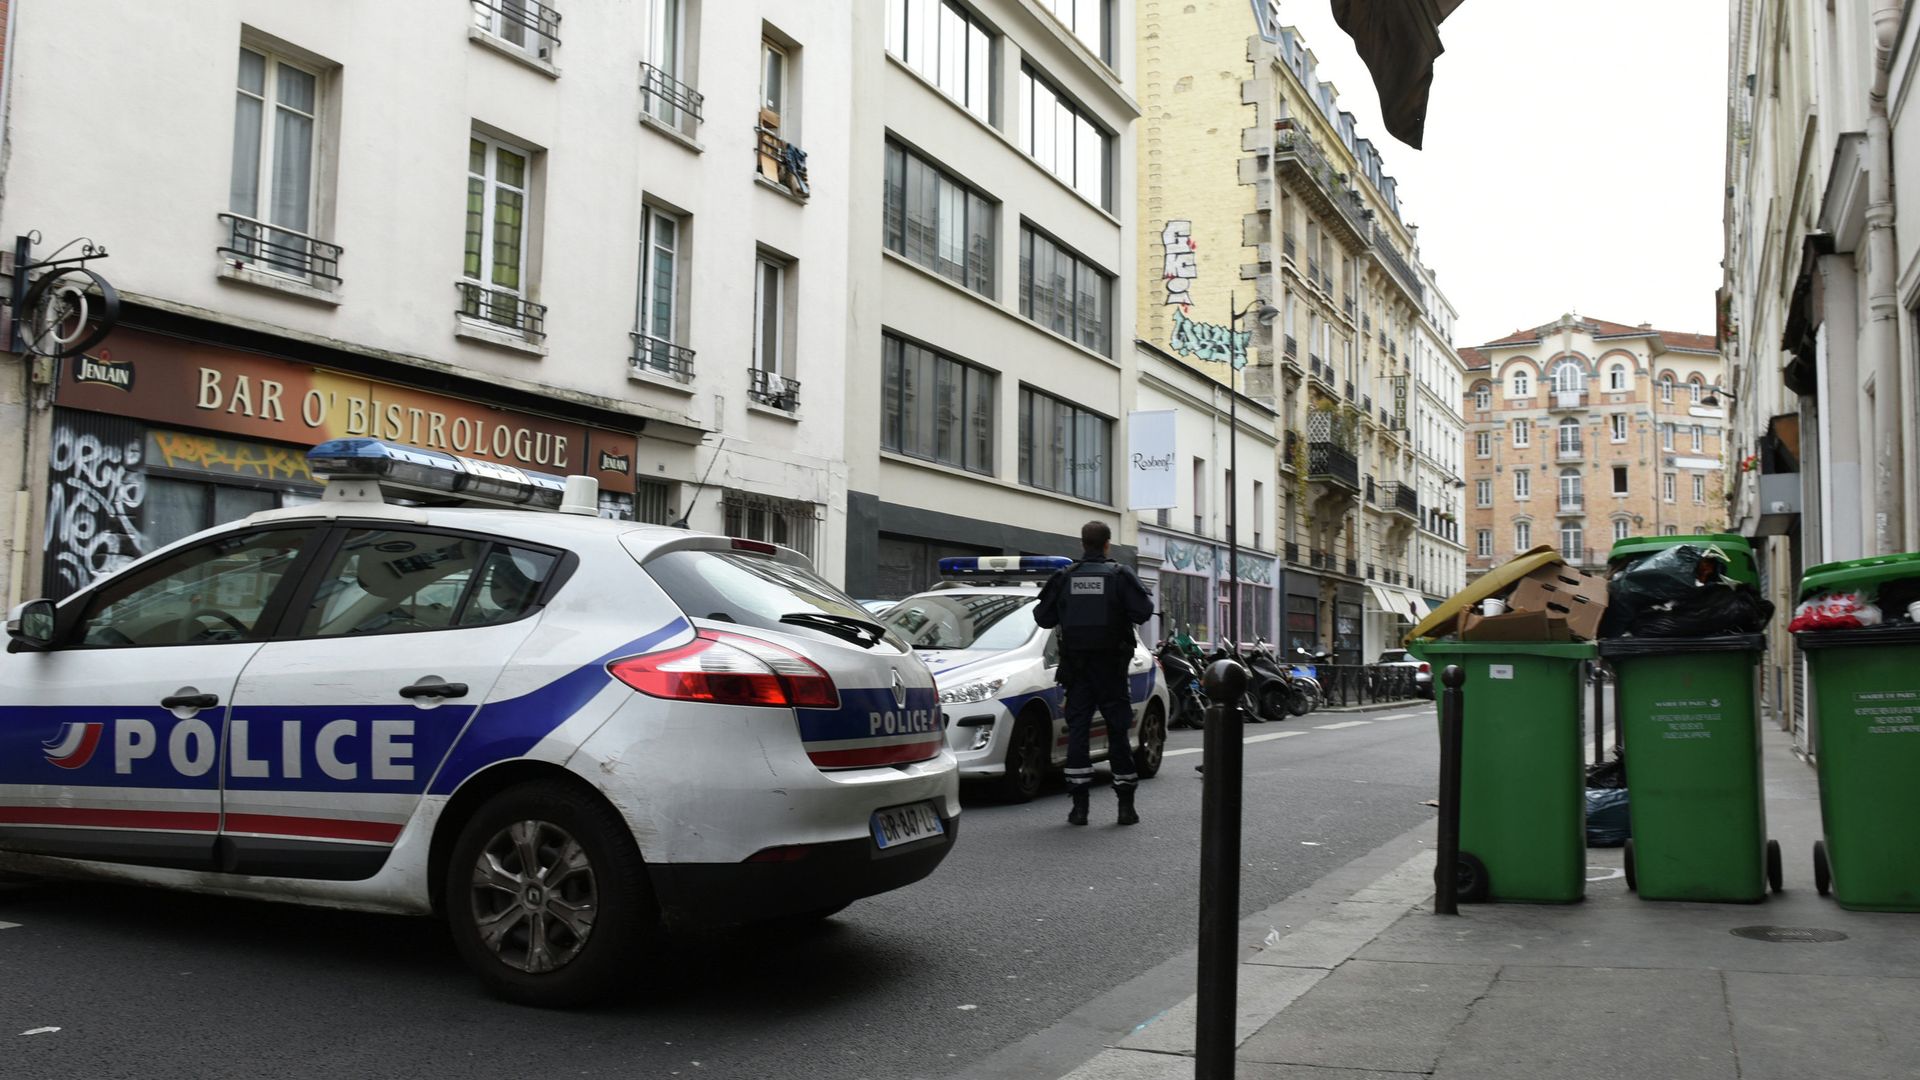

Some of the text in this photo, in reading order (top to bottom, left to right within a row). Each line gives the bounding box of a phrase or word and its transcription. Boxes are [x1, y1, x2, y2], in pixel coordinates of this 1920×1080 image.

[78, 359, 129, 385] JENLAIN
[197, 367, 285, 422] BAR
[347, 396, 569, 469] BISTROLOGUE
[1073, 581, 1102, 590] POLICE
[869, 709, 929, 736] POLICE
[114, 718, 416, 781] POLICE
